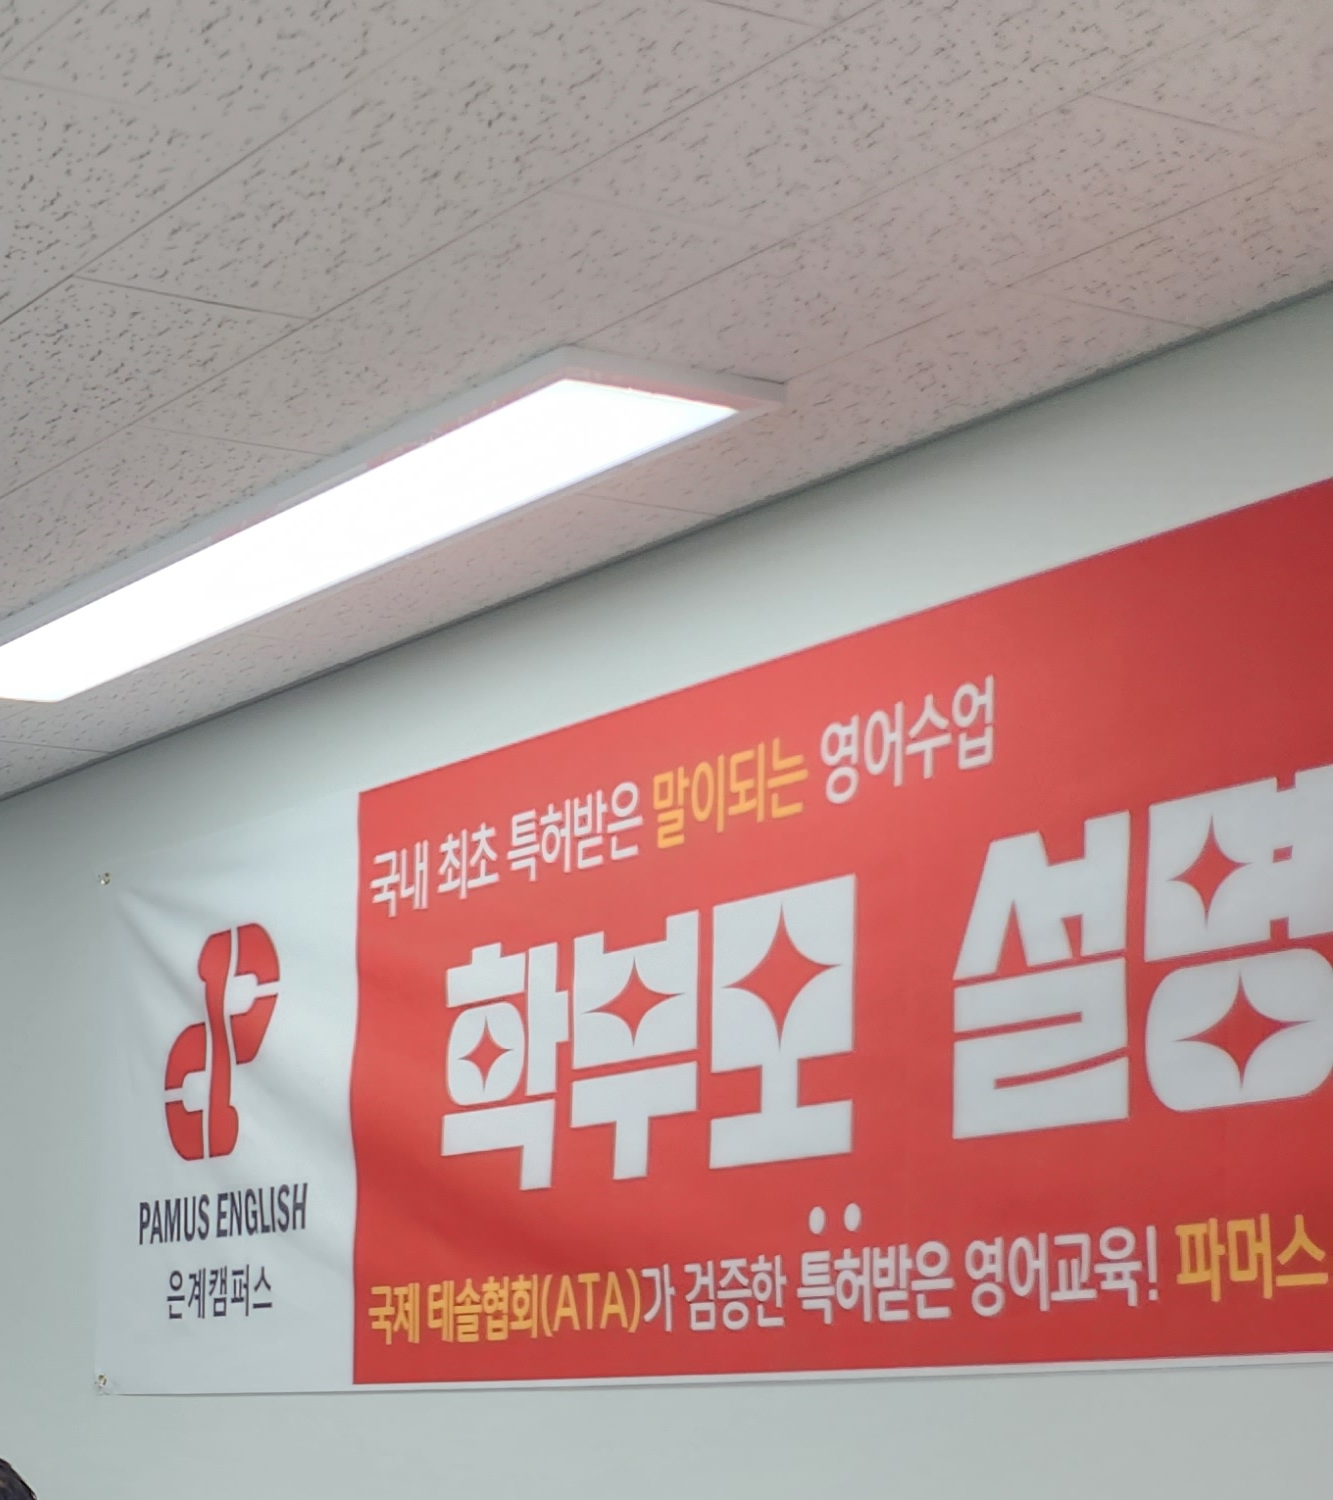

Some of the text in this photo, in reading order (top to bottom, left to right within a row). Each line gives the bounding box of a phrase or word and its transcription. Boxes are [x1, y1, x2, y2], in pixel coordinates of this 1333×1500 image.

[370, 673, 995, 918] 국내 최초 특허받은 말이되는 영어수업
[440, 873, 857, 1191] 학부모
[139, 1182, 309, 1246] PAMUS ENGLISH
[368, 1213, 1330, 1346] 국제 테솔협회(ATA)가 검증한 특허받은 영어교육! 파머스
[167, 1264, 273, 1320] 은계캠퍼스
